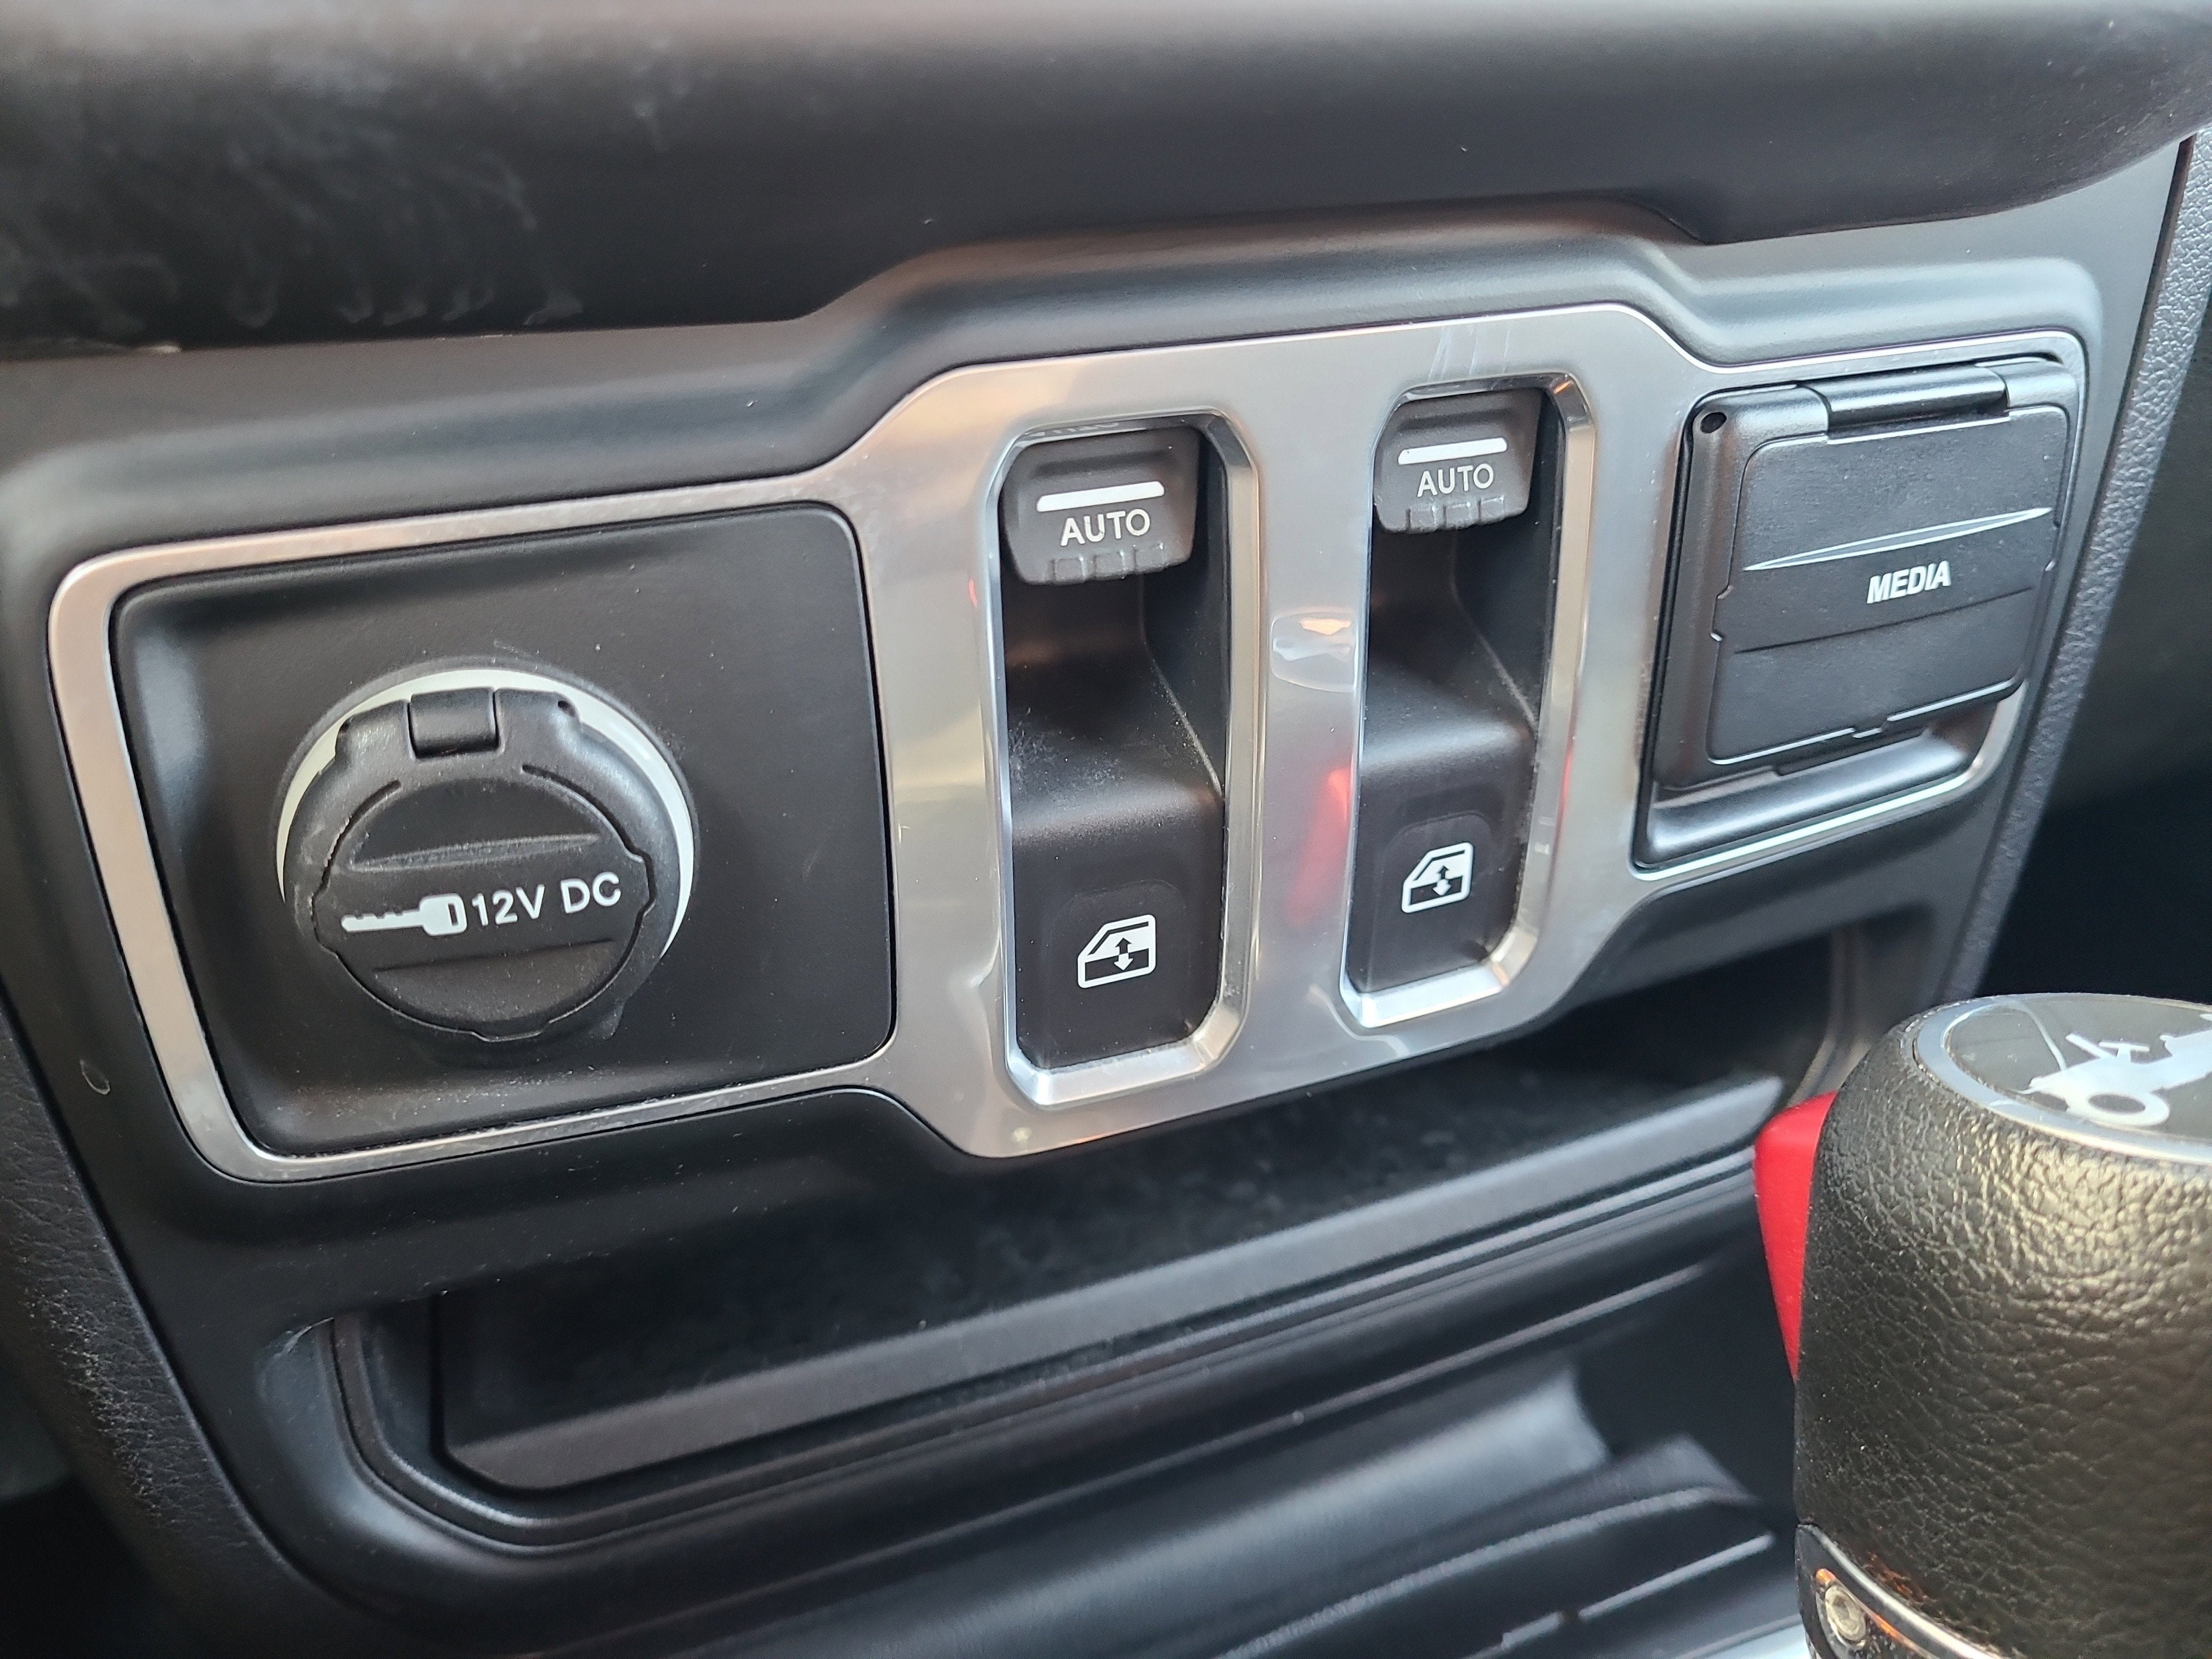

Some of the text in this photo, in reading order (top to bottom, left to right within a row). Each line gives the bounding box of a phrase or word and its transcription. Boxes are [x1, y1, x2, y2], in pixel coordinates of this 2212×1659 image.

[1417, 462, 1494, 498] AUTO
[1060, 509, 1151, 546] AUTO
[1866, 561, 1951, 604] MEDIA
[472, 871, 622, 927] 12V DC
